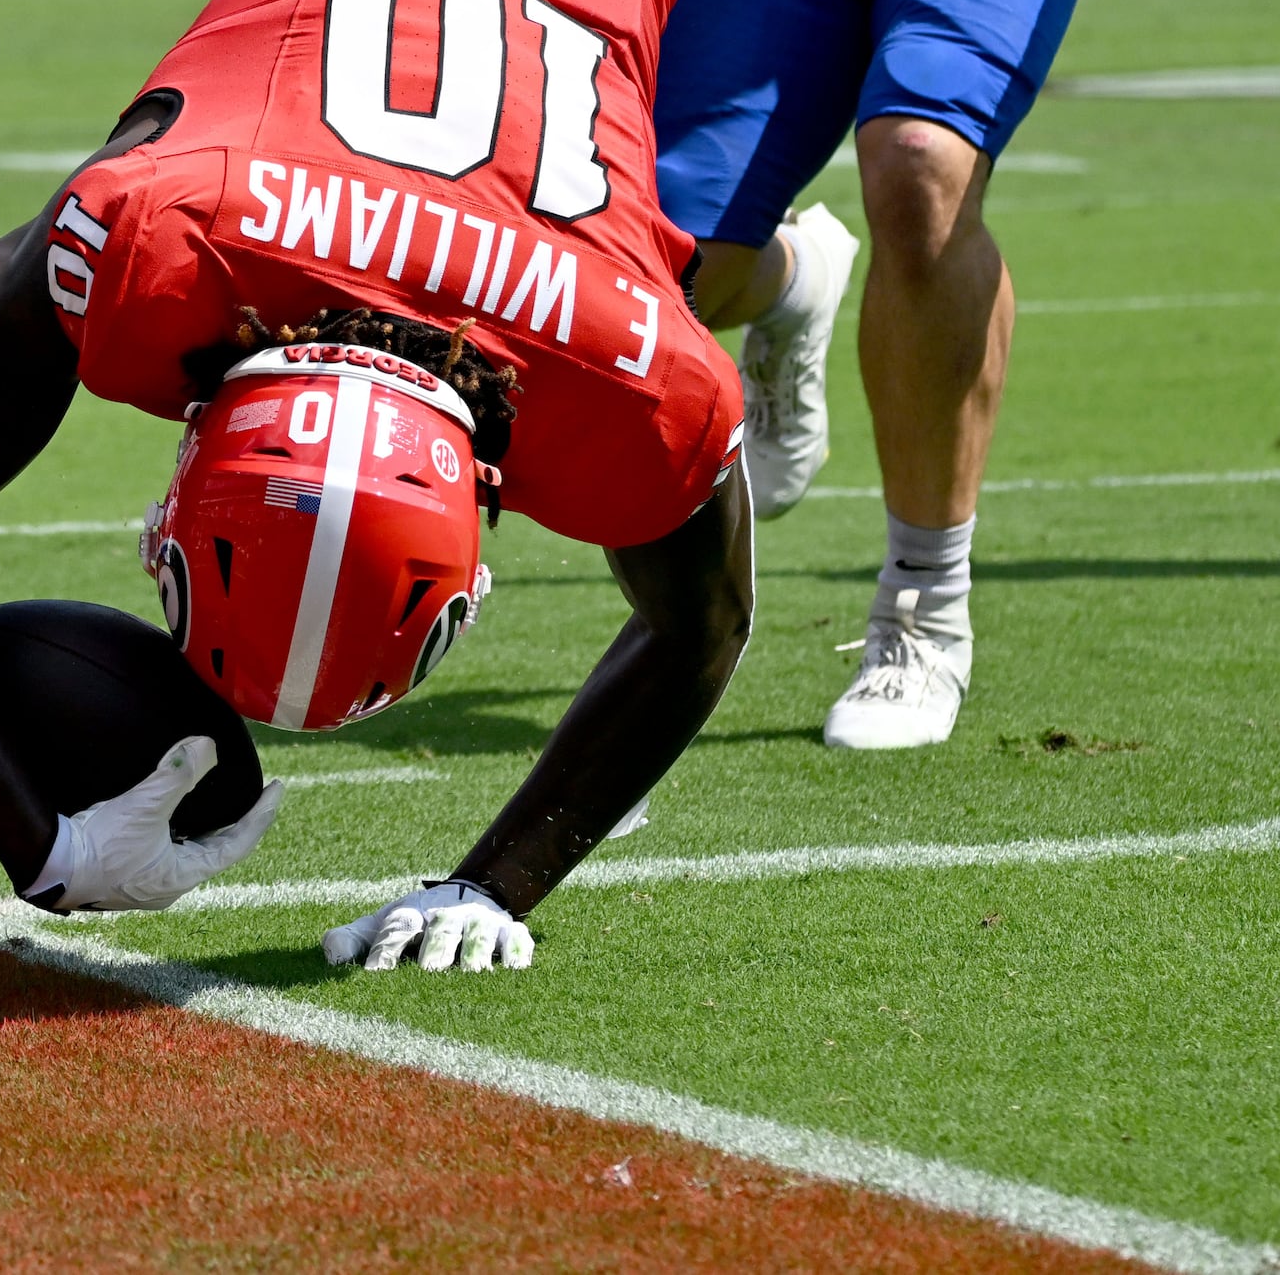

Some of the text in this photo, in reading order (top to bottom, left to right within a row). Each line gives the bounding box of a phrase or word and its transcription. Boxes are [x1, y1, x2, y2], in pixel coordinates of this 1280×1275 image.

[47, 191, 111, 318] 10
[240, 159, 660, 378] E. WILLIAMS
[283, 345, 439, 392] GEORGIA
[288, 391, 399, 459] 10
[433, 440, 459, 480] SEC
